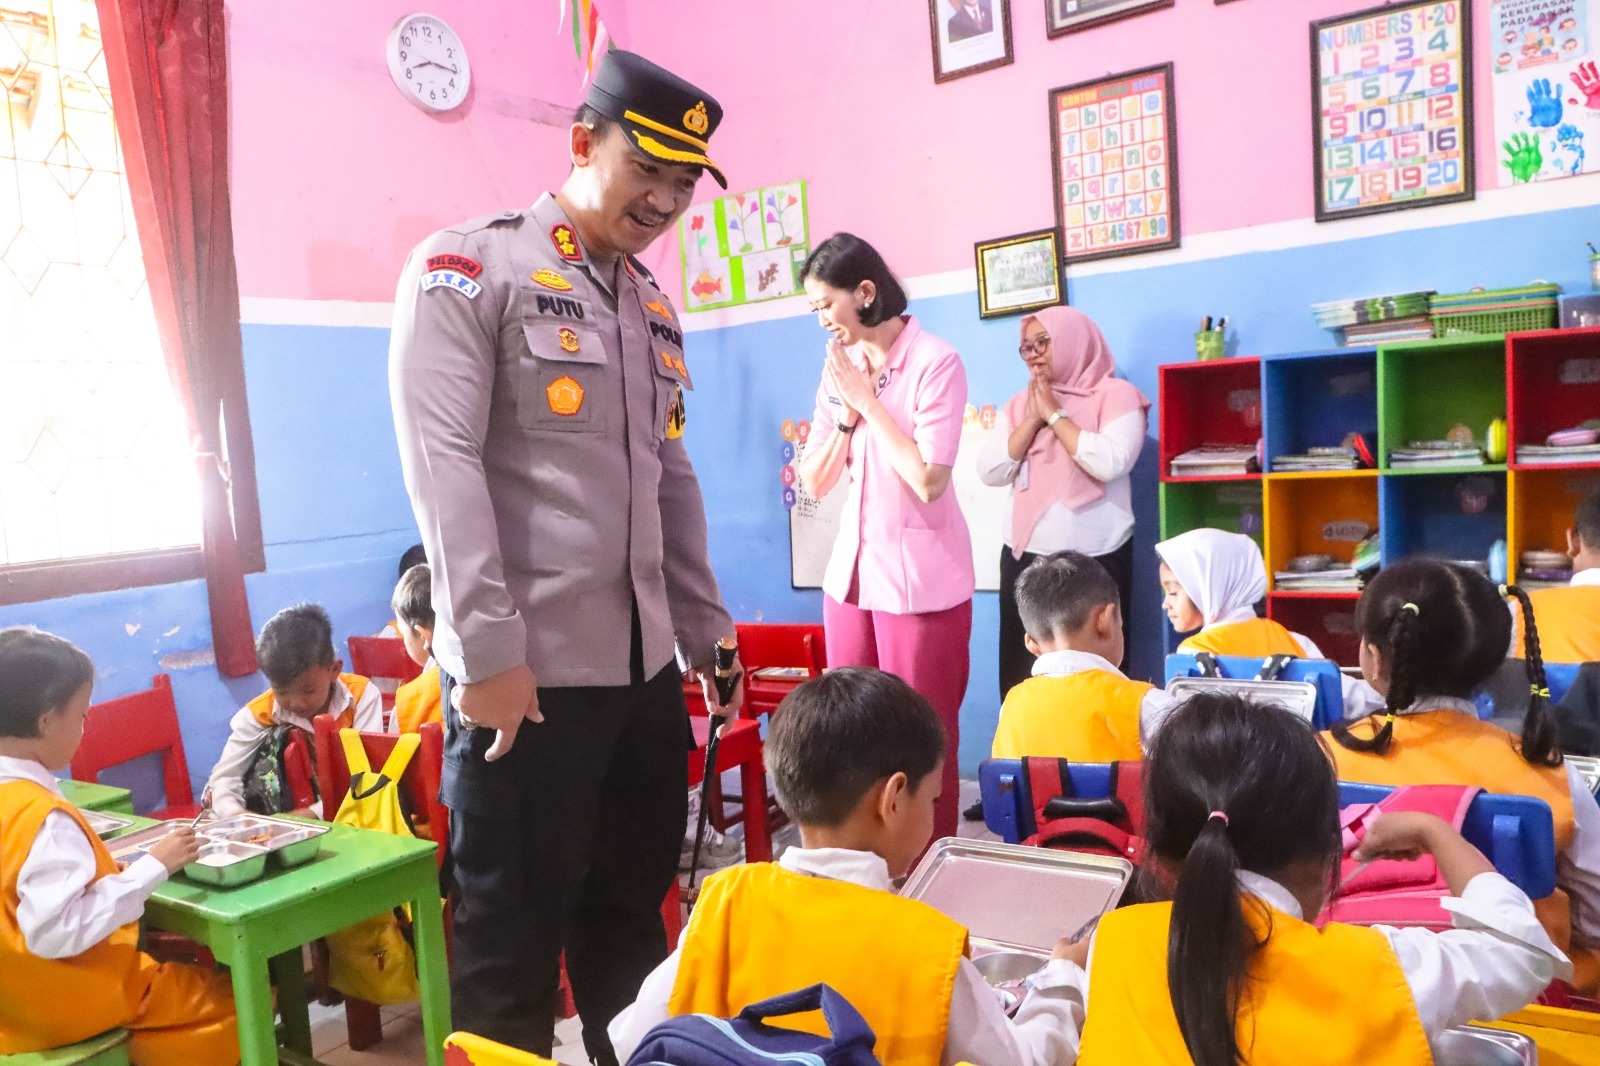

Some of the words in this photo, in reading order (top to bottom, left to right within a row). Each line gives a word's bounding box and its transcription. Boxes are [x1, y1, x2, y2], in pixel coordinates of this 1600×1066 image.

[410, 26, 417, 38] 11
[422, 26, 432, 37] 12
[1320, 12, 1412, 51] NUMBERS
[1418, 2, 1456, 30] 1-20
[1501, 15, 1534, 28] PADA
[400, 36, 411, 47] 10
[400, 50, 407, 62] 9
[446, 48, 453, 58] 2
[1333, 52, 1339, 74] 1
[1360, 44, 1379, 68] 2
[1394, 36, 1414, 61] 3
[1428, 28, 1448, 52] 4
[406, 68, 412, 79] 8
[417, 83, 422, 93] 7
[449, 78, 455, 88] 4
[1328, 82, 1346, 108] 5
[1362, 76, 1380, 100] 6
[1395, 68, 1415, 93] 7
[1430, 62, 1451, 87] 8
[430, 90, 436, 100] 6
[442, 88, 448, 98] 5
[1064, 112, 1077, 128] a
[1084, 107, 1097, 126] b
[1104, 103, 1118, 119] c
[1125, 97, 1138, 117] d
[1145, 94, 1159, 111] e
[1329, 115, 1348, 138] 9
[1360, 108, 1386, 132] 10
[1398, 102, 1414, 125] 11
[1427, 94, 1454, 121] 12
[1067, 134, 1076, 154] f
[1085, 130, 1098, 150] g
[1105, 128, 1118, 146] h
[1130, 123, 1135, 141] i
[1327, 146, 1354, 169] 13
[1360, 139, 1387, 164] 14
[1393, 134, 1420, 159] 15
[1428, 127, 1456, 153] 16
[1066, 160, 1079, 178] k
[1103, 152, 1122, 169] m
[1126, 149, 1140, 166] n
[1147, 145, 1161, 161] o
[1067, 183, 1080, 202] p
[1087, 179, 1100, 198] q
[1108, 177, 1118, 194] r
[1128, 174, 1141, 190] s
[1151, 168, 1160, 187] t
[1328, 176, 1354, 202] 17
[1361, 172, 1388, 198] 18
[1394, 166, 1422, 190] 19
[1427, 160, 1458, 185] 20
[1068, 208, 1081, 224] u
[1088, 205, 1101, 221] v
[1106, 201, 1124, 218] w
[1129, 198, 1143, 215] x
[1149, 193, 1163, 213] y
[1070, 232, 1082, 248] z
[424, 273, 474, 295] PARA
[536, 294, 584, 320] PUTU
[650, 320, 682, 350] POLR
